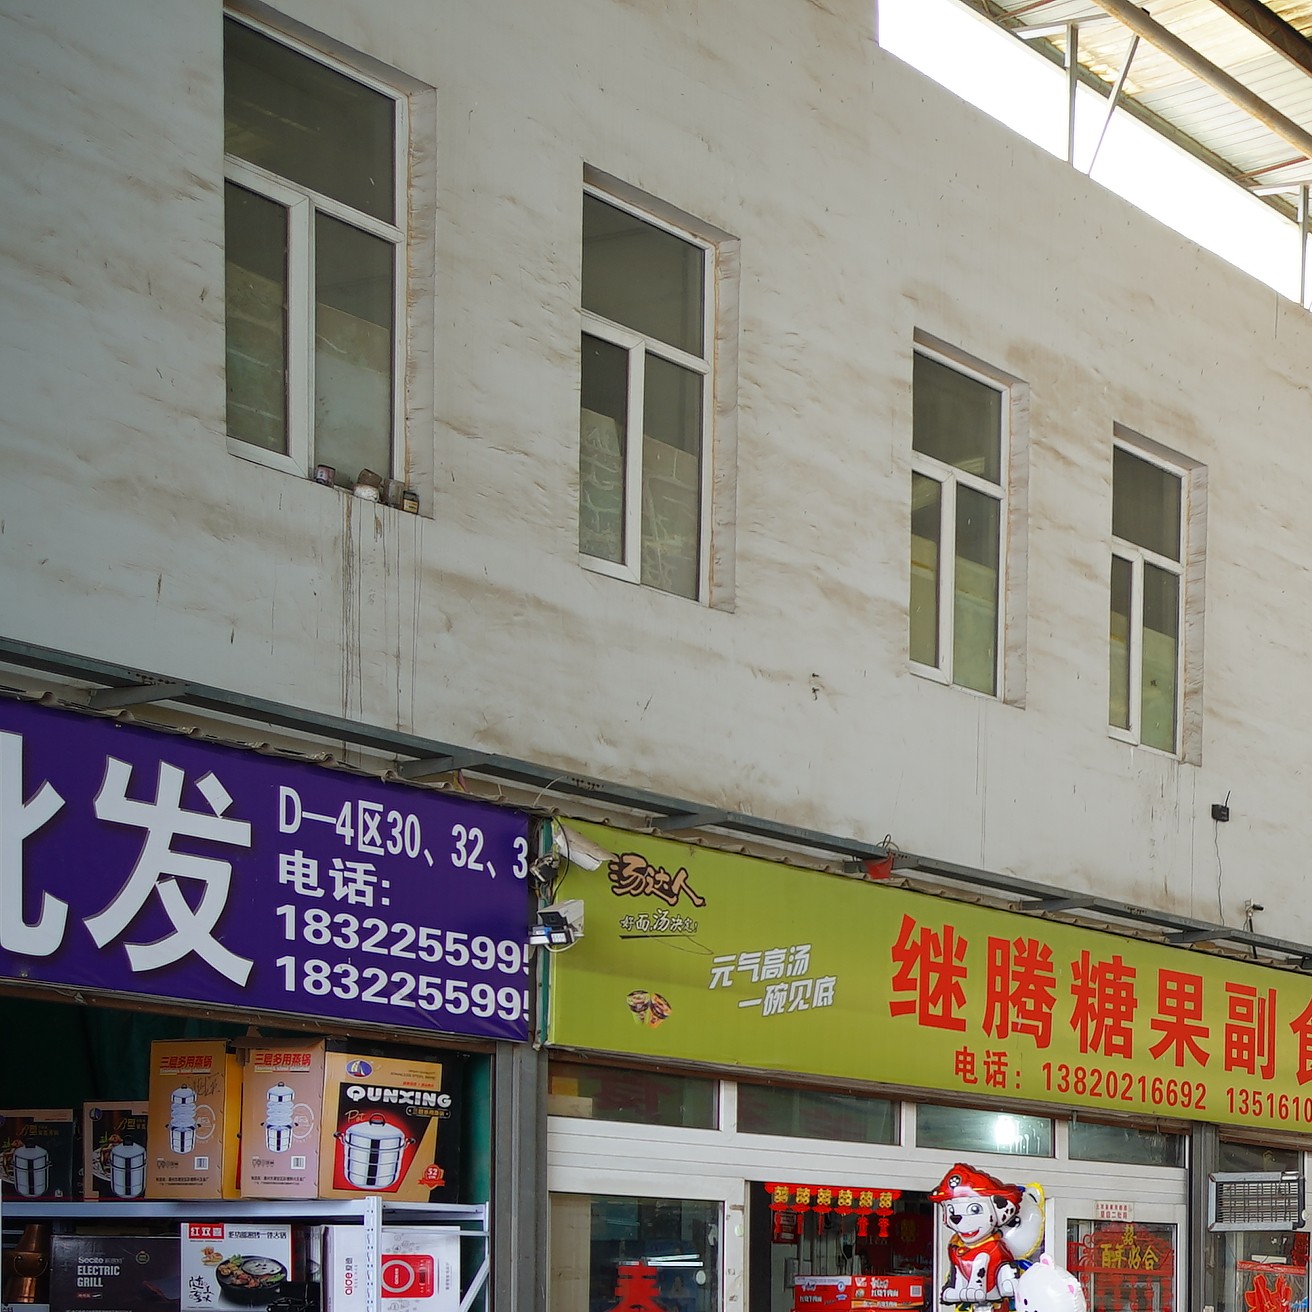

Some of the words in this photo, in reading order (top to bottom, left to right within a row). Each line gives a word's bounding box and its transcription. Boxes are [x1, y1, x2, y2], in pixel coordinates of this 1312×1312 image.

[609, 853, 706, 907] 汤达人
[709, 944, 812, 988] 元气高汤
[738, 976, 838, 1017] 一碗见底
[346, 1085, 452, 1108] QUNXING
[1100, 1243, 1158, 1270] 百年好合
[77, 1265, 121, 1276] ELECTRIC
[77, 1277, 104, 1288] GRILL
